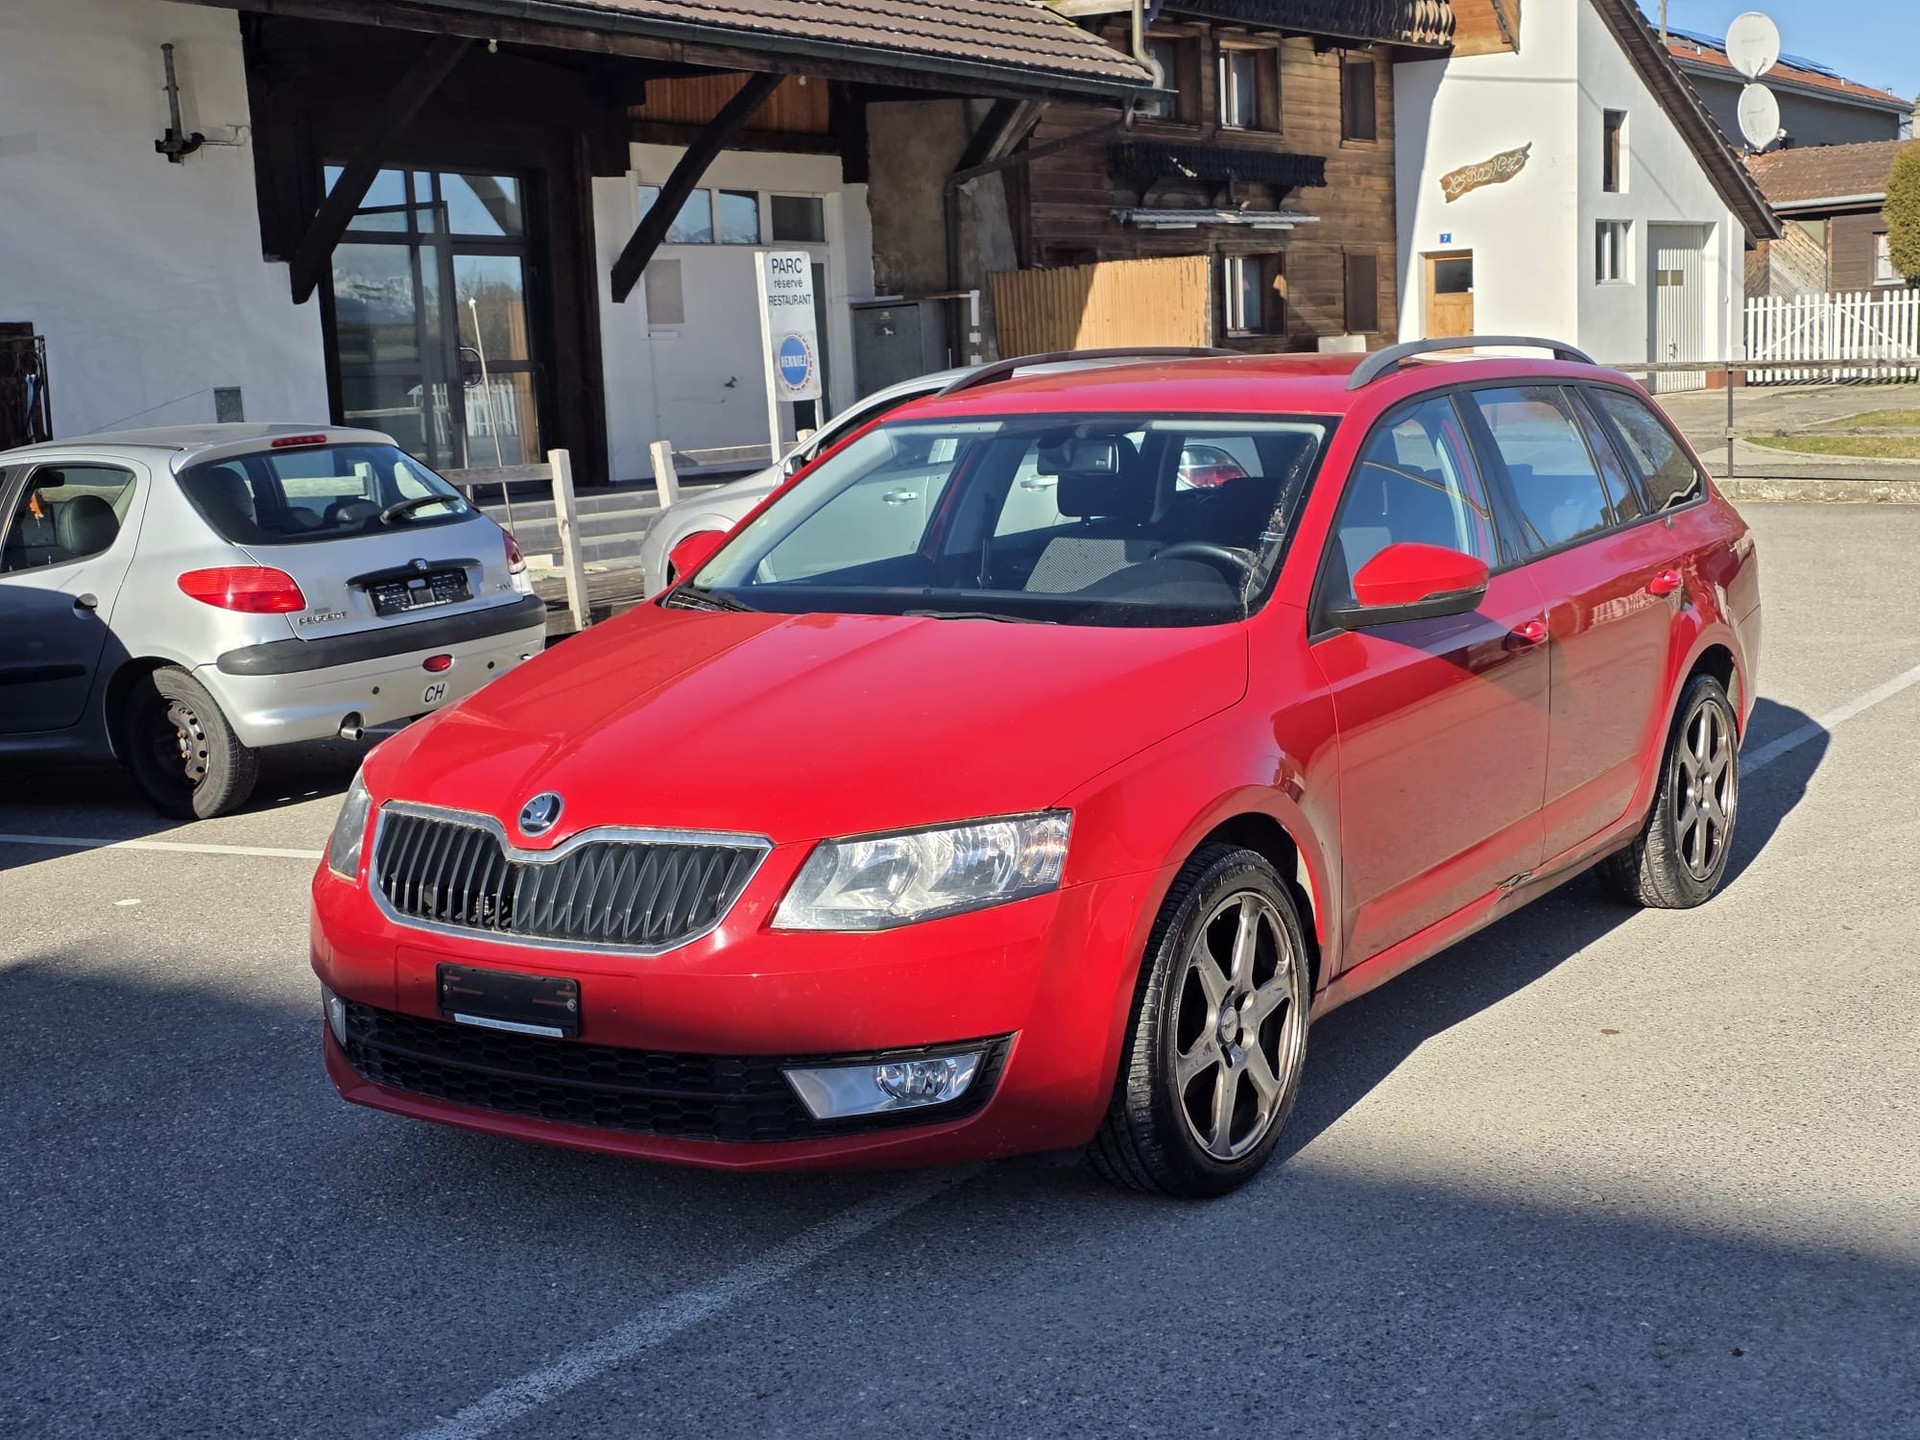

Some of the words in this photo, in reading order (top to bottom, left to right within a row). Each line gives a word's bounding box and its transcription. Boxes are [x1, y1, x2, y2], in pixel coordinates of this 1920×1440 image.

[772, 258, 802, 274] PARC
[773, 278, 804, 289] réservé
[769, 294, 811, 306] RESTAURANT
[780, 355, 808, 368] HENNIEZ
[424, 684, 445, 703] CH
